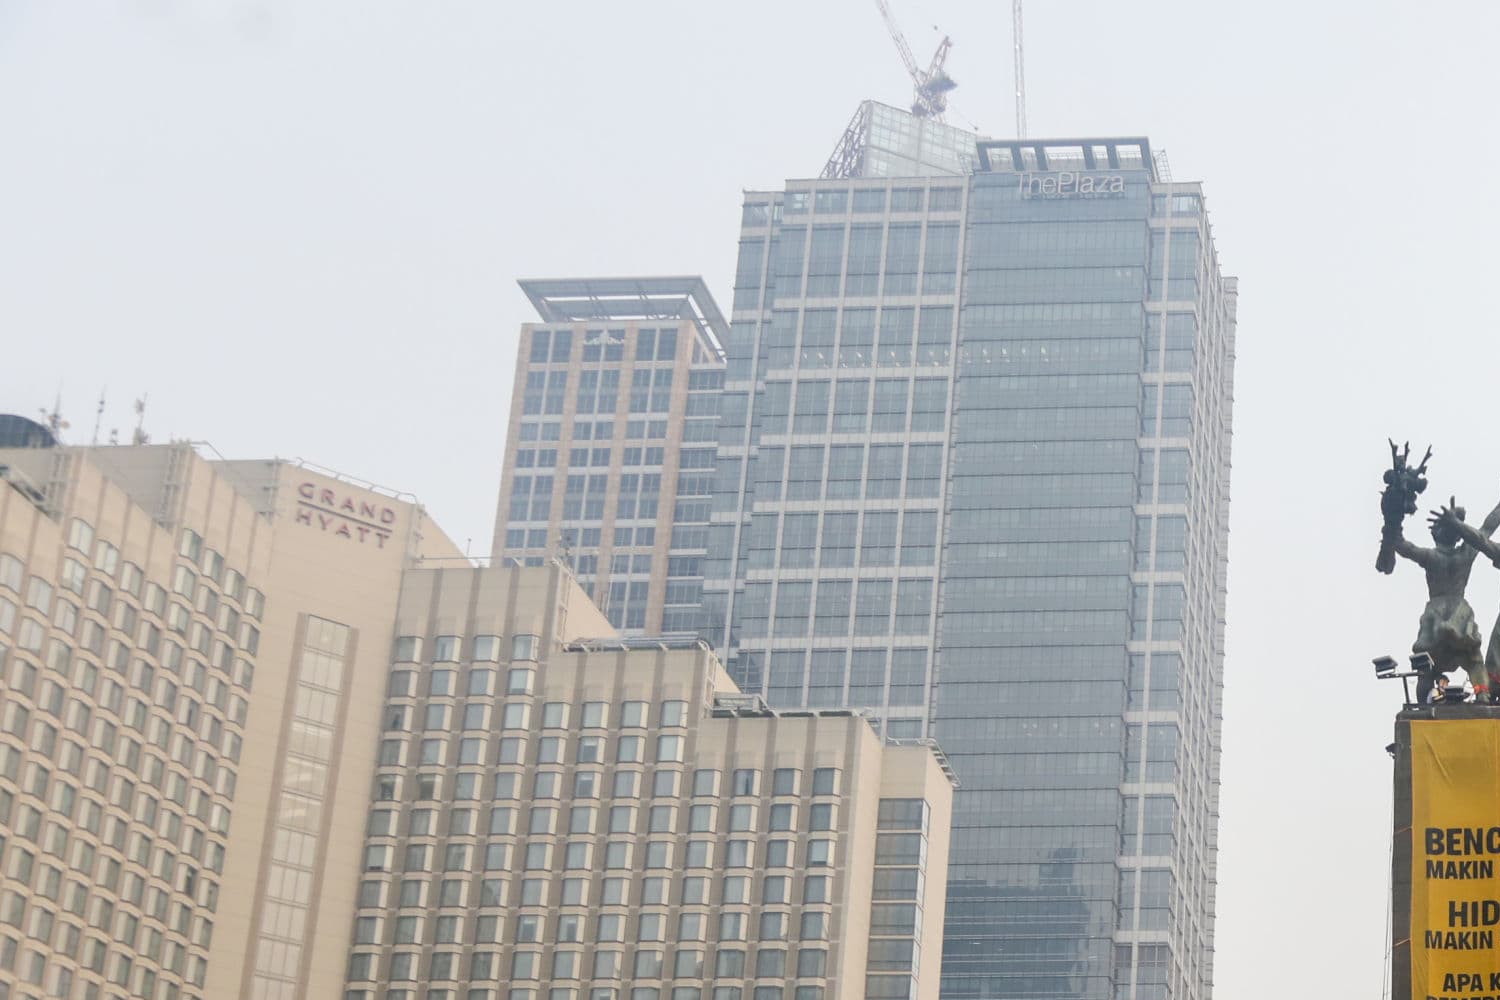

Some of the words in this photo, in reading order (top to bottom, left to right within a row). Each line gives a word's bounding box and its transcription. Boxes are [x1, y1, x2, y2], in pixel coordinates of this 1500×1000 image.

[298, 482, 396, 524] GRAND
[296, 509, 390, 548] HYATT
[1425, 860, 1493, 880] MAKIN
[1424, 929, 1493, 950] MAKIN
[1443, 973, 1484, 993] APA
